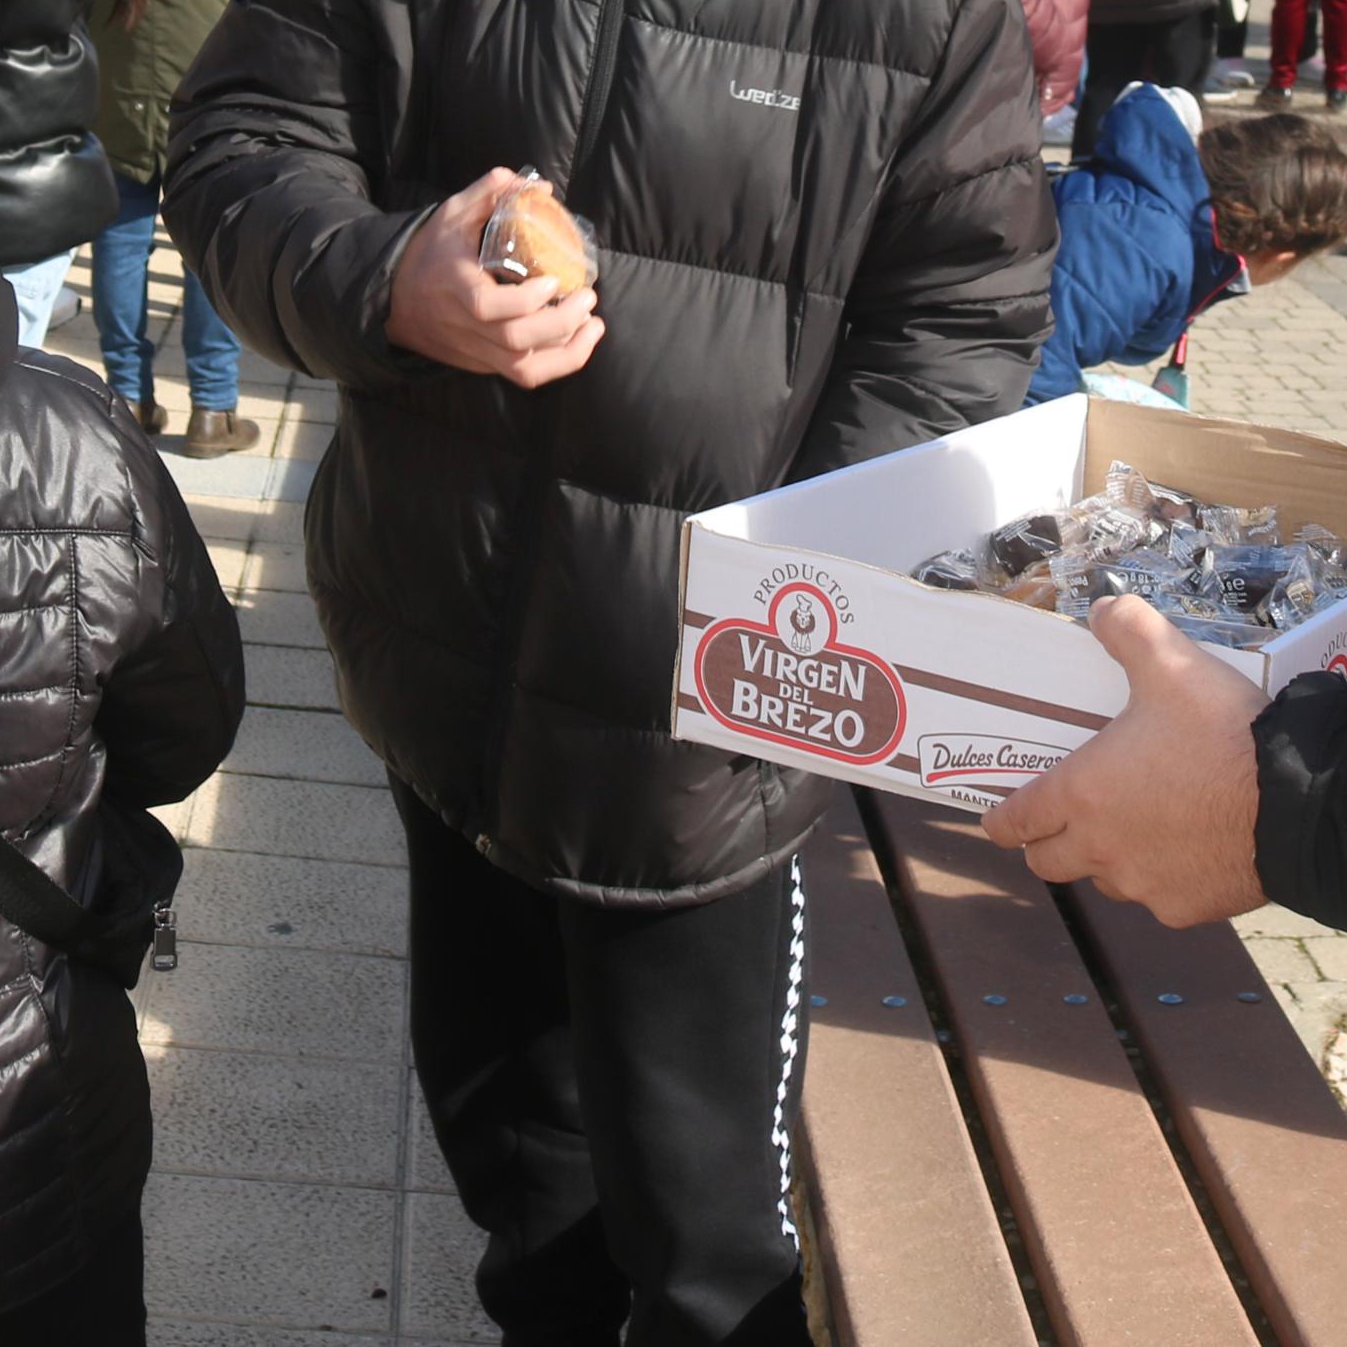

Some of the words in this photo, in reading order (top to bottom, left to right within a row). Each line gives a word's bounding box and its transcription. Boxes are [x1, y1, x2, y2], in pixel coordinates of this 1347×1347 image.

[753, 563, 854, 624] PRODUCTOS
[738, 633, 868, 701] VIRGEN
[730, 678, 865, 748] BREZO
[778, 682, 813, 705] DEL
[932, 743, 994, 770] Dulces
[996, 744, 1063, 770] Caseros
[951, 789, 1000, 808] MANTE
